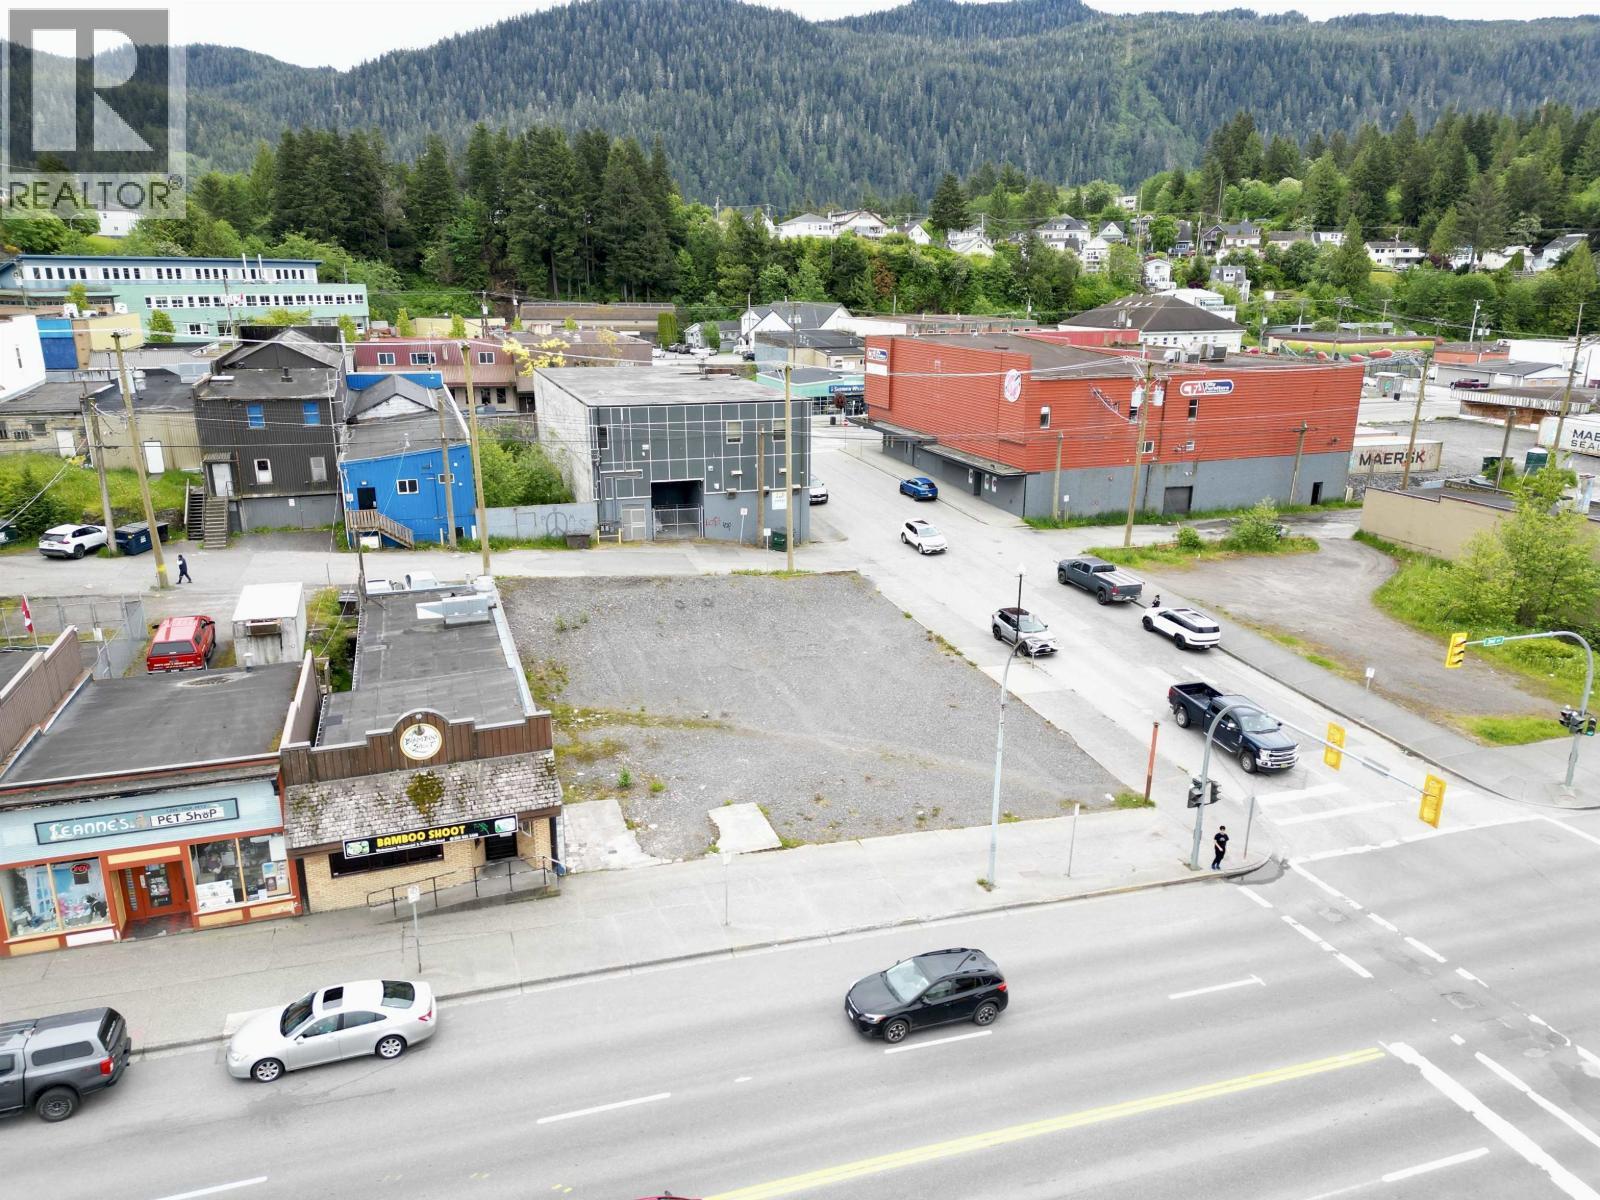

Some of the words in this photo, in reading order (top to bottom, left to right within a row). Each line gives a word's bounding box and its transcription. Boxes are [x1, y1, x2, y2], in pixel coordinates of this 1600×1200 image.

[157, 813, 181, 825] PET
[376, 831, 426, 848] BAMBOO
[428, 825, 466, 840] SHOOT
